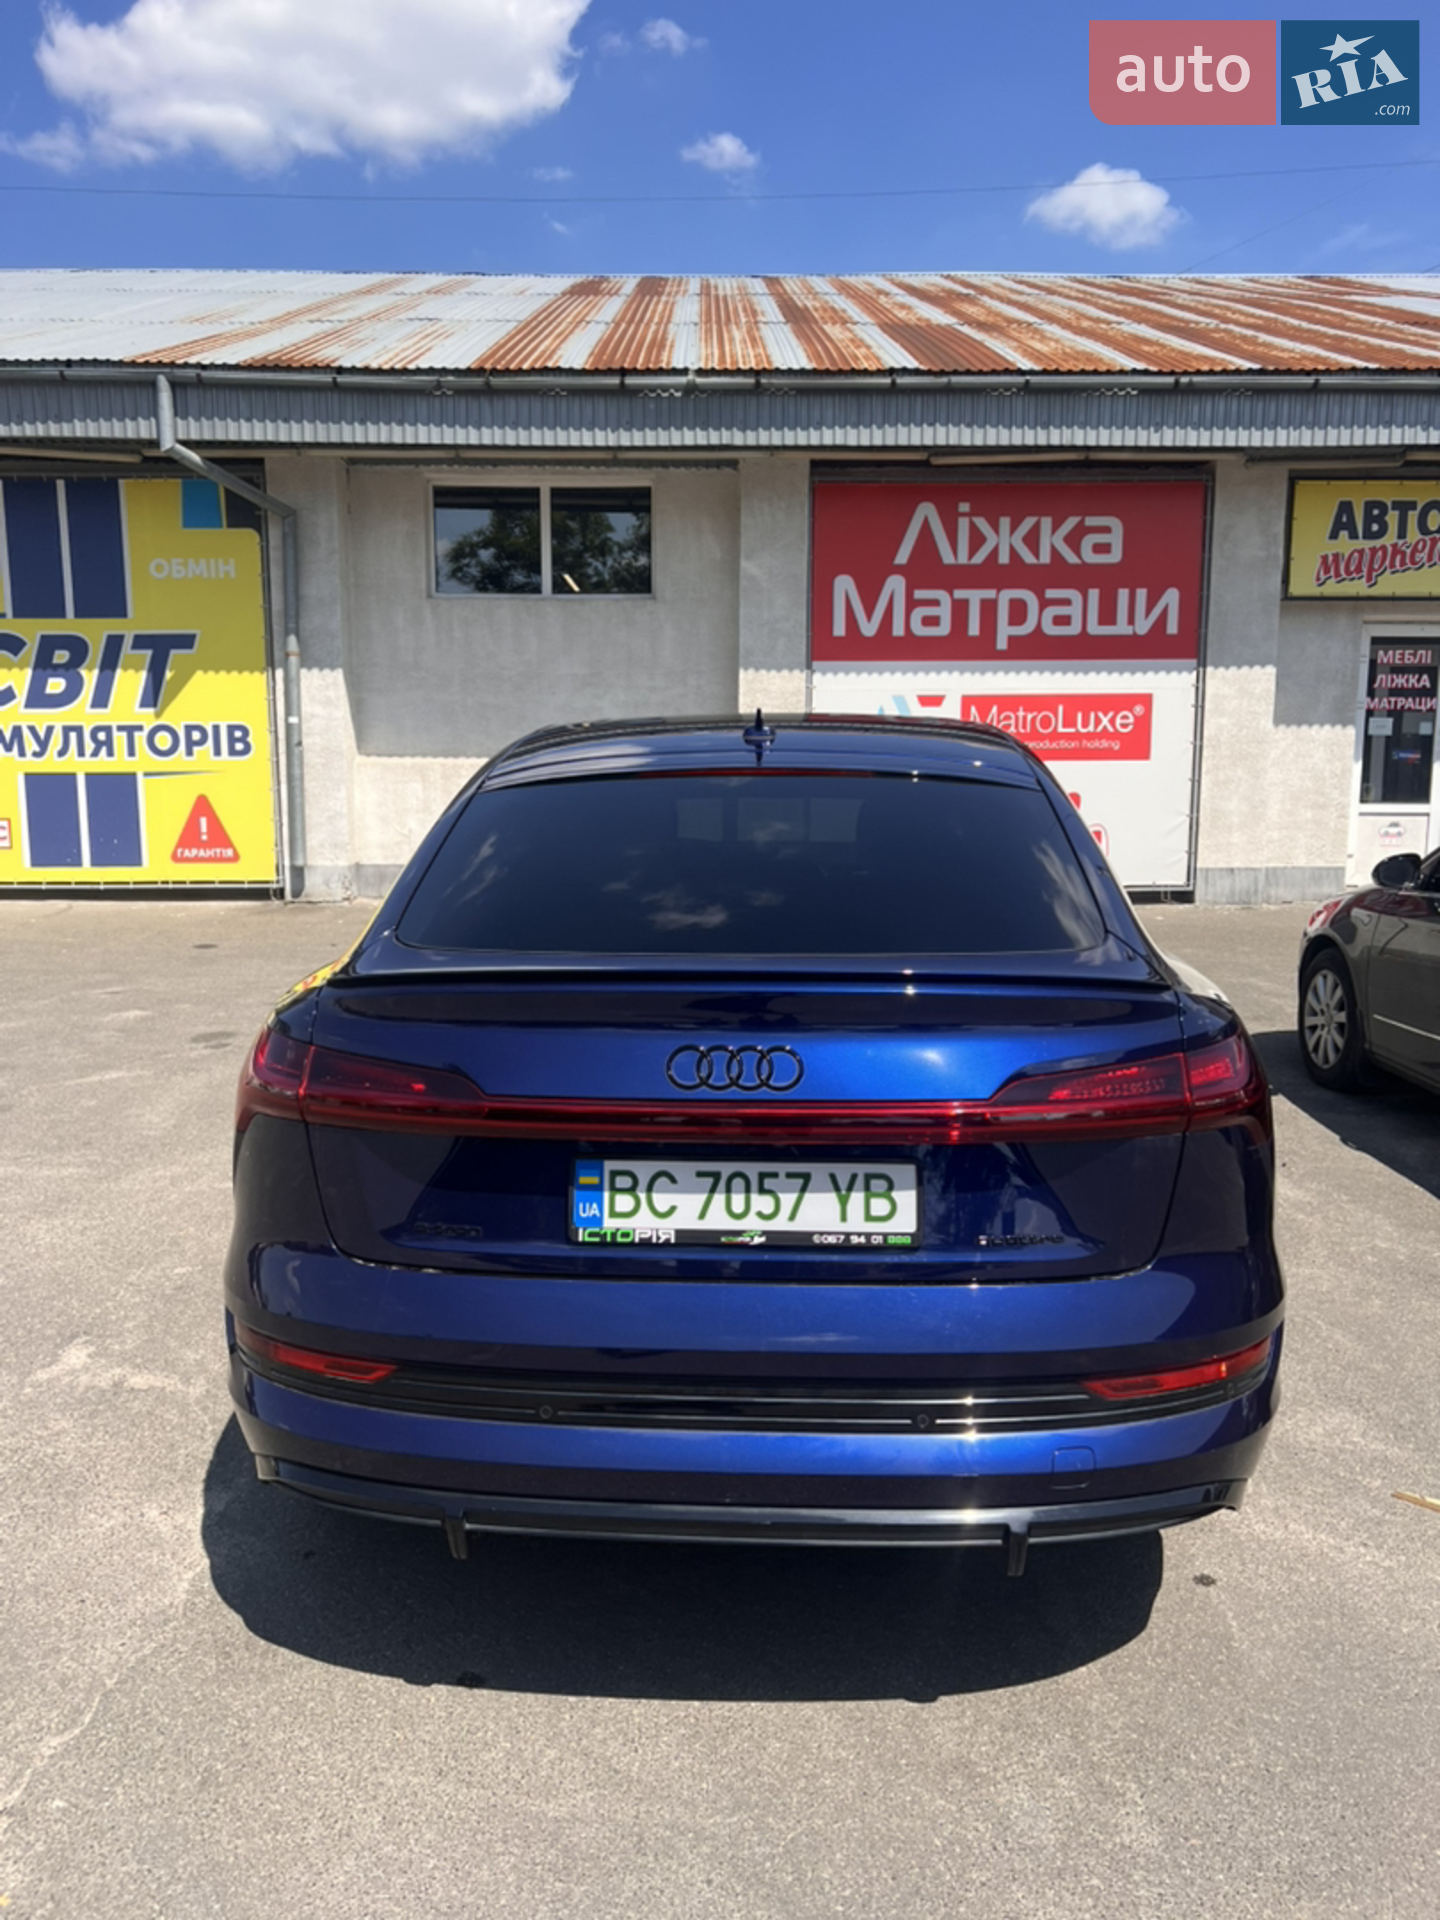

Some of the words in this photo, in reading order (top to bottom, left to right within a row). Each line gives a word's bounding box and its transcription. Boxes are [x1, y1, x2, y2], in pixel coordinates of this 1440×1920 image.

[893, 502, 1124, 565] Ліжка
[149, 558, 236, 579] ОБМІН
[832, 574, 1180, 650] Матраци
[1377, 649, 1432, 664] МЕБЛІ
[1373, 673, 1431, 689] ЛІЖКА
[1365, 696, 1437, 713] МАТРАЦИ
[1082, 738, 1120, 750] holding
[177, 848, 234, 858] ГАРАНТІЯ
[608, 1169, 678, 1219] BC
[695, 1171, 811, 1222] 7057
[828, 1172, 897, 1223] YB
[579, 1203, 600, 1217] UA
